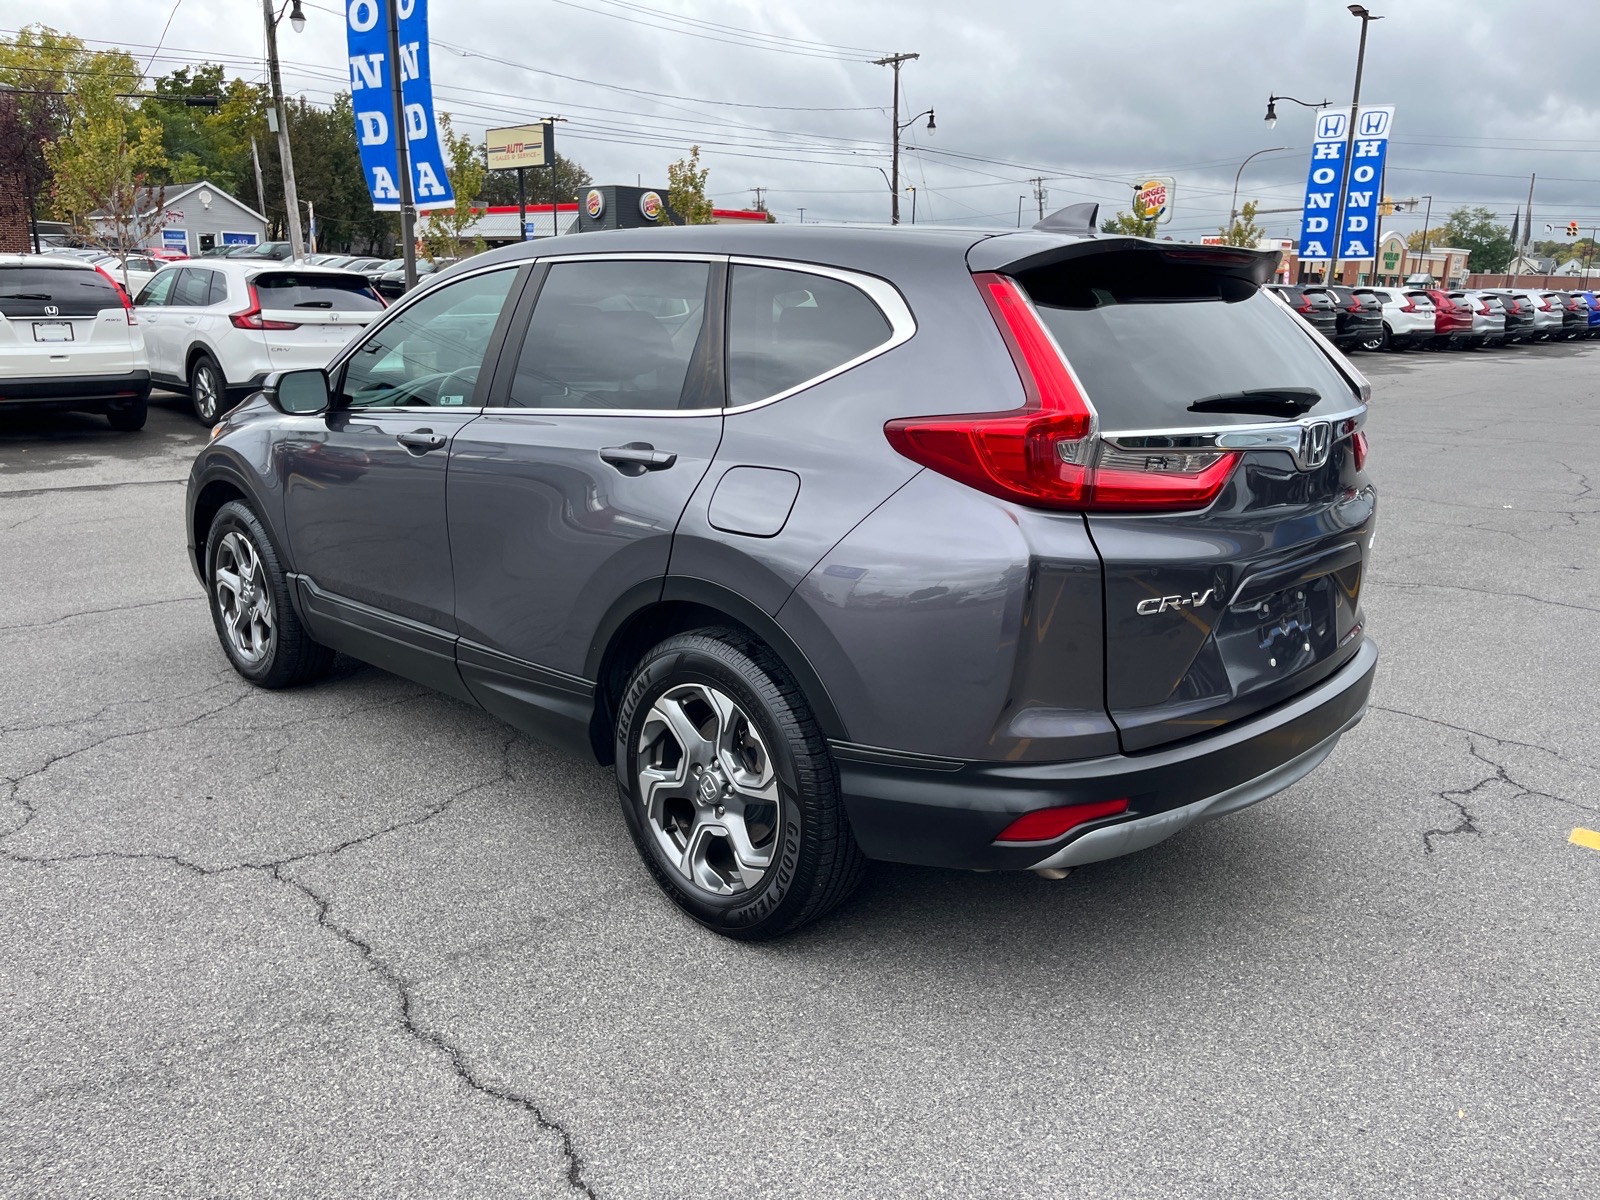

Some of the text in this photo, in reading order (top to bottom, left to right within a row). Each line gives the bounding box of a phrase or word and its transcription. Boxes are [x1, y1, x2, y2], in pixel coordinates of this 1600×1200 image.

[505, 142, 524, 154] AUTO
[517, 151, 537, 159] SERVICE
[1139, 186, 1166, 200] URGER
[1143, 194, 1166, 209] ING
[1303, 142, 1342, 256] HONDA
[1344, 140, 1382, 256] HONDA
[1136, 588, 1214, 616] CR-V
[618, 667, 652, 746] RELIANT
[738, 821, 799, 921] GOODYEAR
